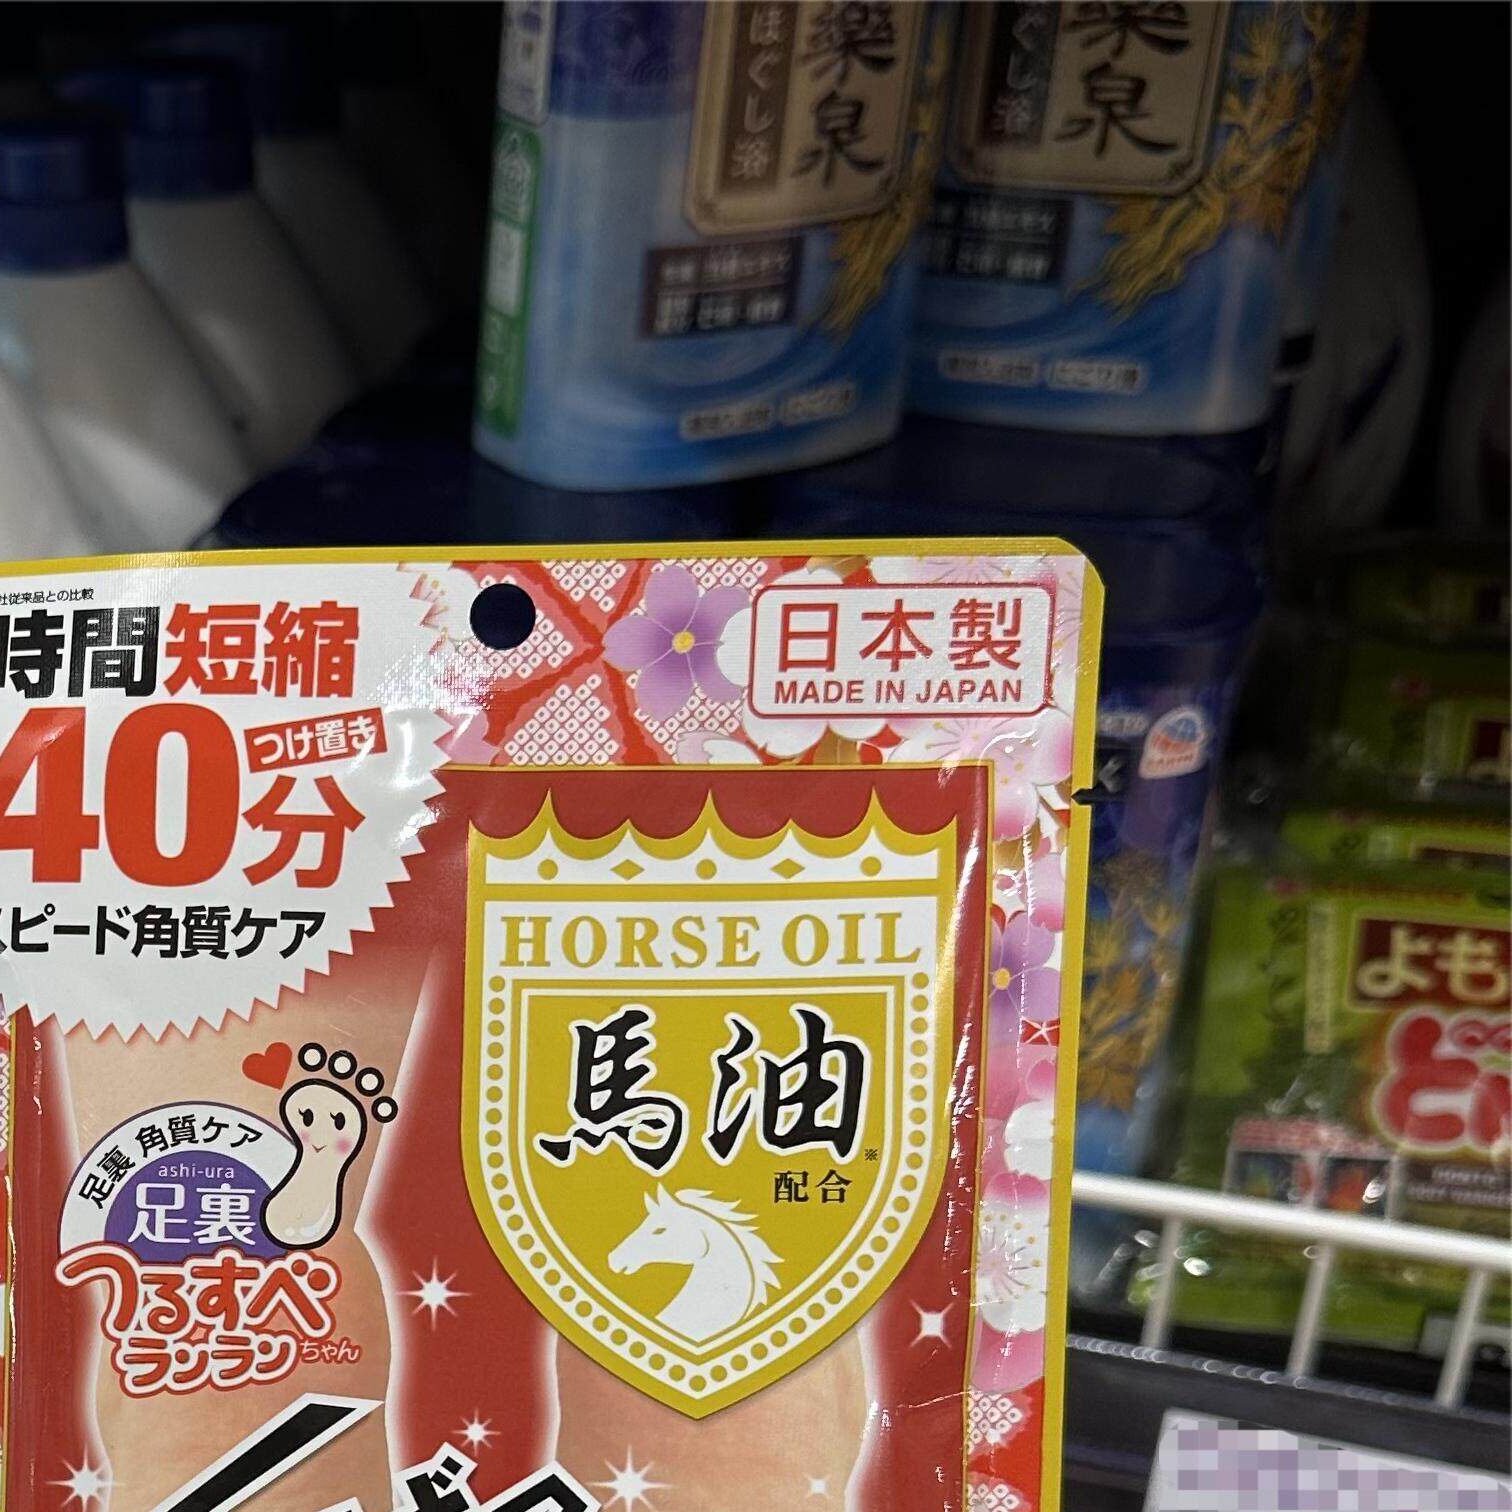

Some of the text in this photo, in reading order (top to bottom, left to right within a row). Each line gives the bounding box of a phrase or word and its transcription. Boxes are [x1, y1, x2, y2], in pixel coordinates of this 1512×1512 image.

[777, 597, 1025, 674] 日本製
[774, 678, 1023, 705] MADE IN JAPAN
[252, 713, 382, 767] つけ置き
[498, 911, 922, 969] HORSE OIL
[538, 1007, 868, 1174] 馬油
[78, 1113, 264, 1210] 足裏 角質ケア
[157, 1162, 236, 1180] ashi-ura
[772, 1168, 854, 1204] 配合
[127, 1181, 257, 1247] 足裏
[60, 1252, 338, 1340] つるすべ
